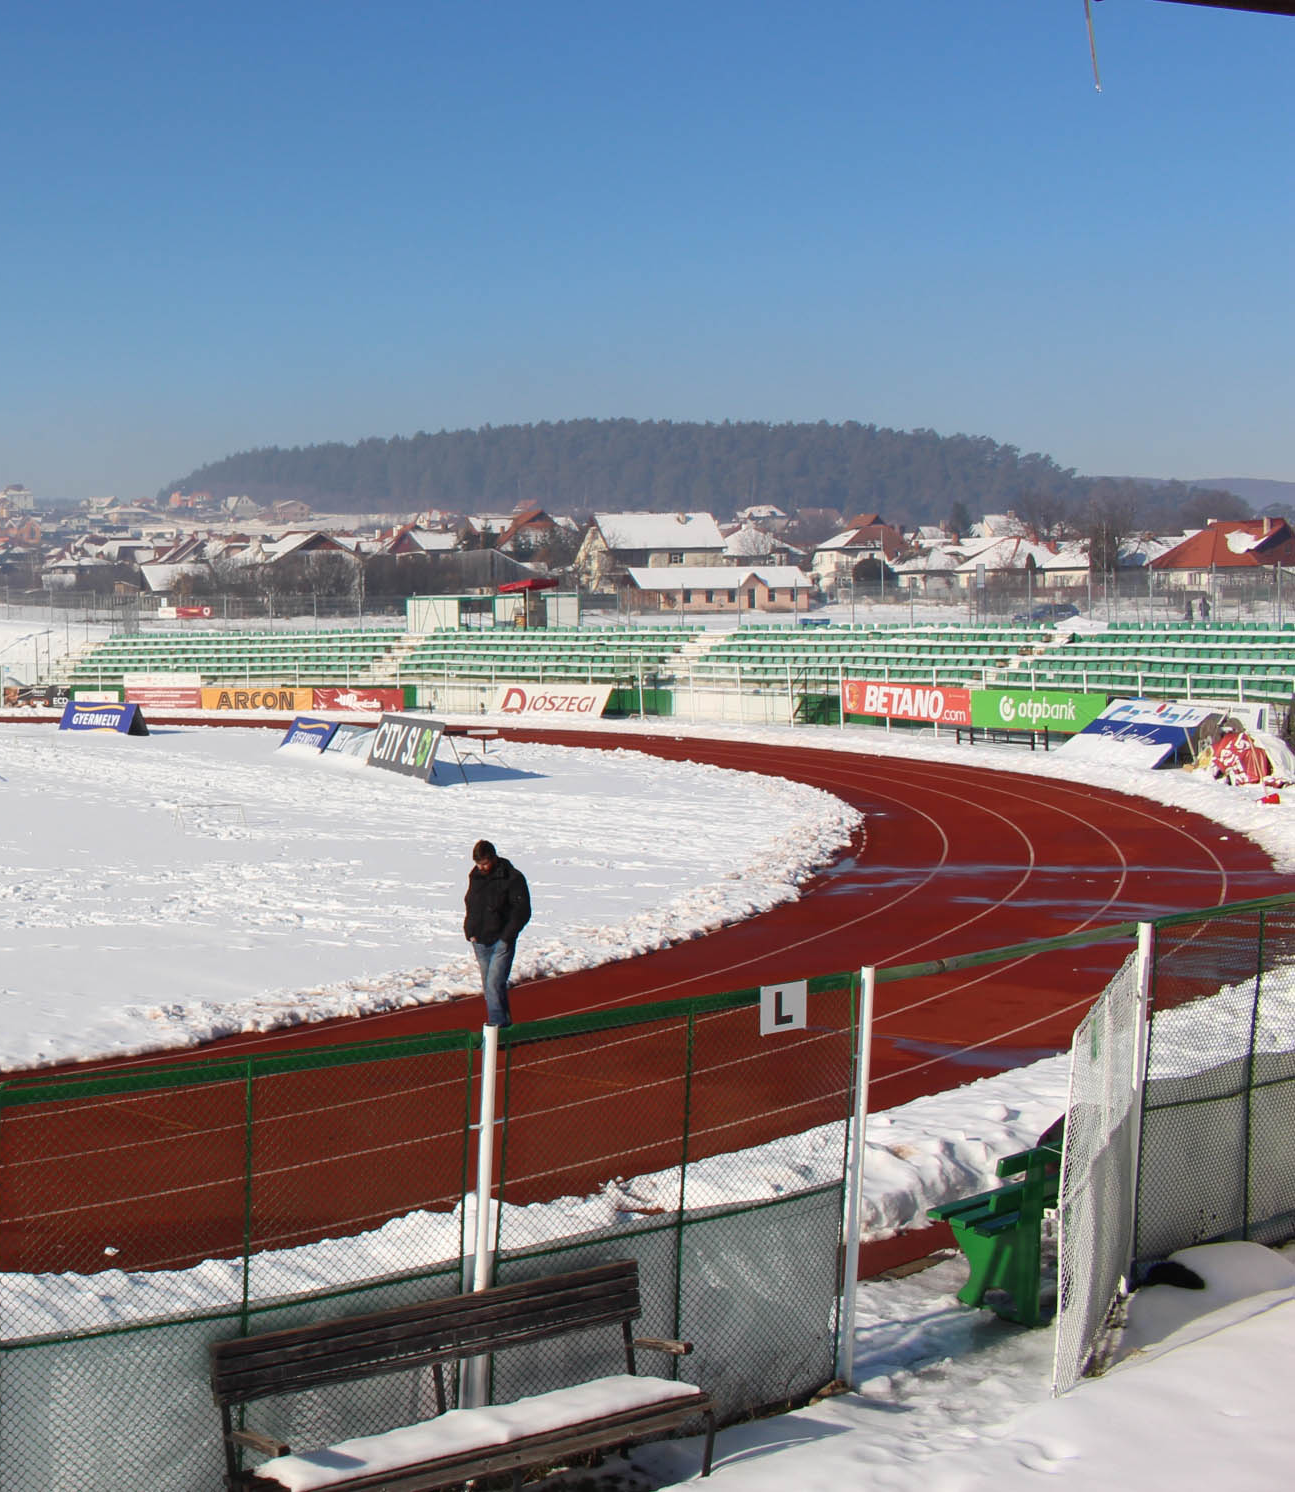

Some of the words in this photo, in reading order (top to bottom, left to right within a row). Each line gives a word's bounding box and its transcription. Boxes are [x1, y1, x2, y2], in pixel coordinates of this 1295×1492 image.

[216, 691, 295, 710] ARCON
[501, 687, 597, 714] DIÓSZEGI
[1018, 696, 1076, 725] otpbank
[72, 713, 120, 726] GYERMELYI
[373, 722, 408, 762] CITY
[401, 728, 441, 769] SLOT
[774, 991, 794, 1026] L
